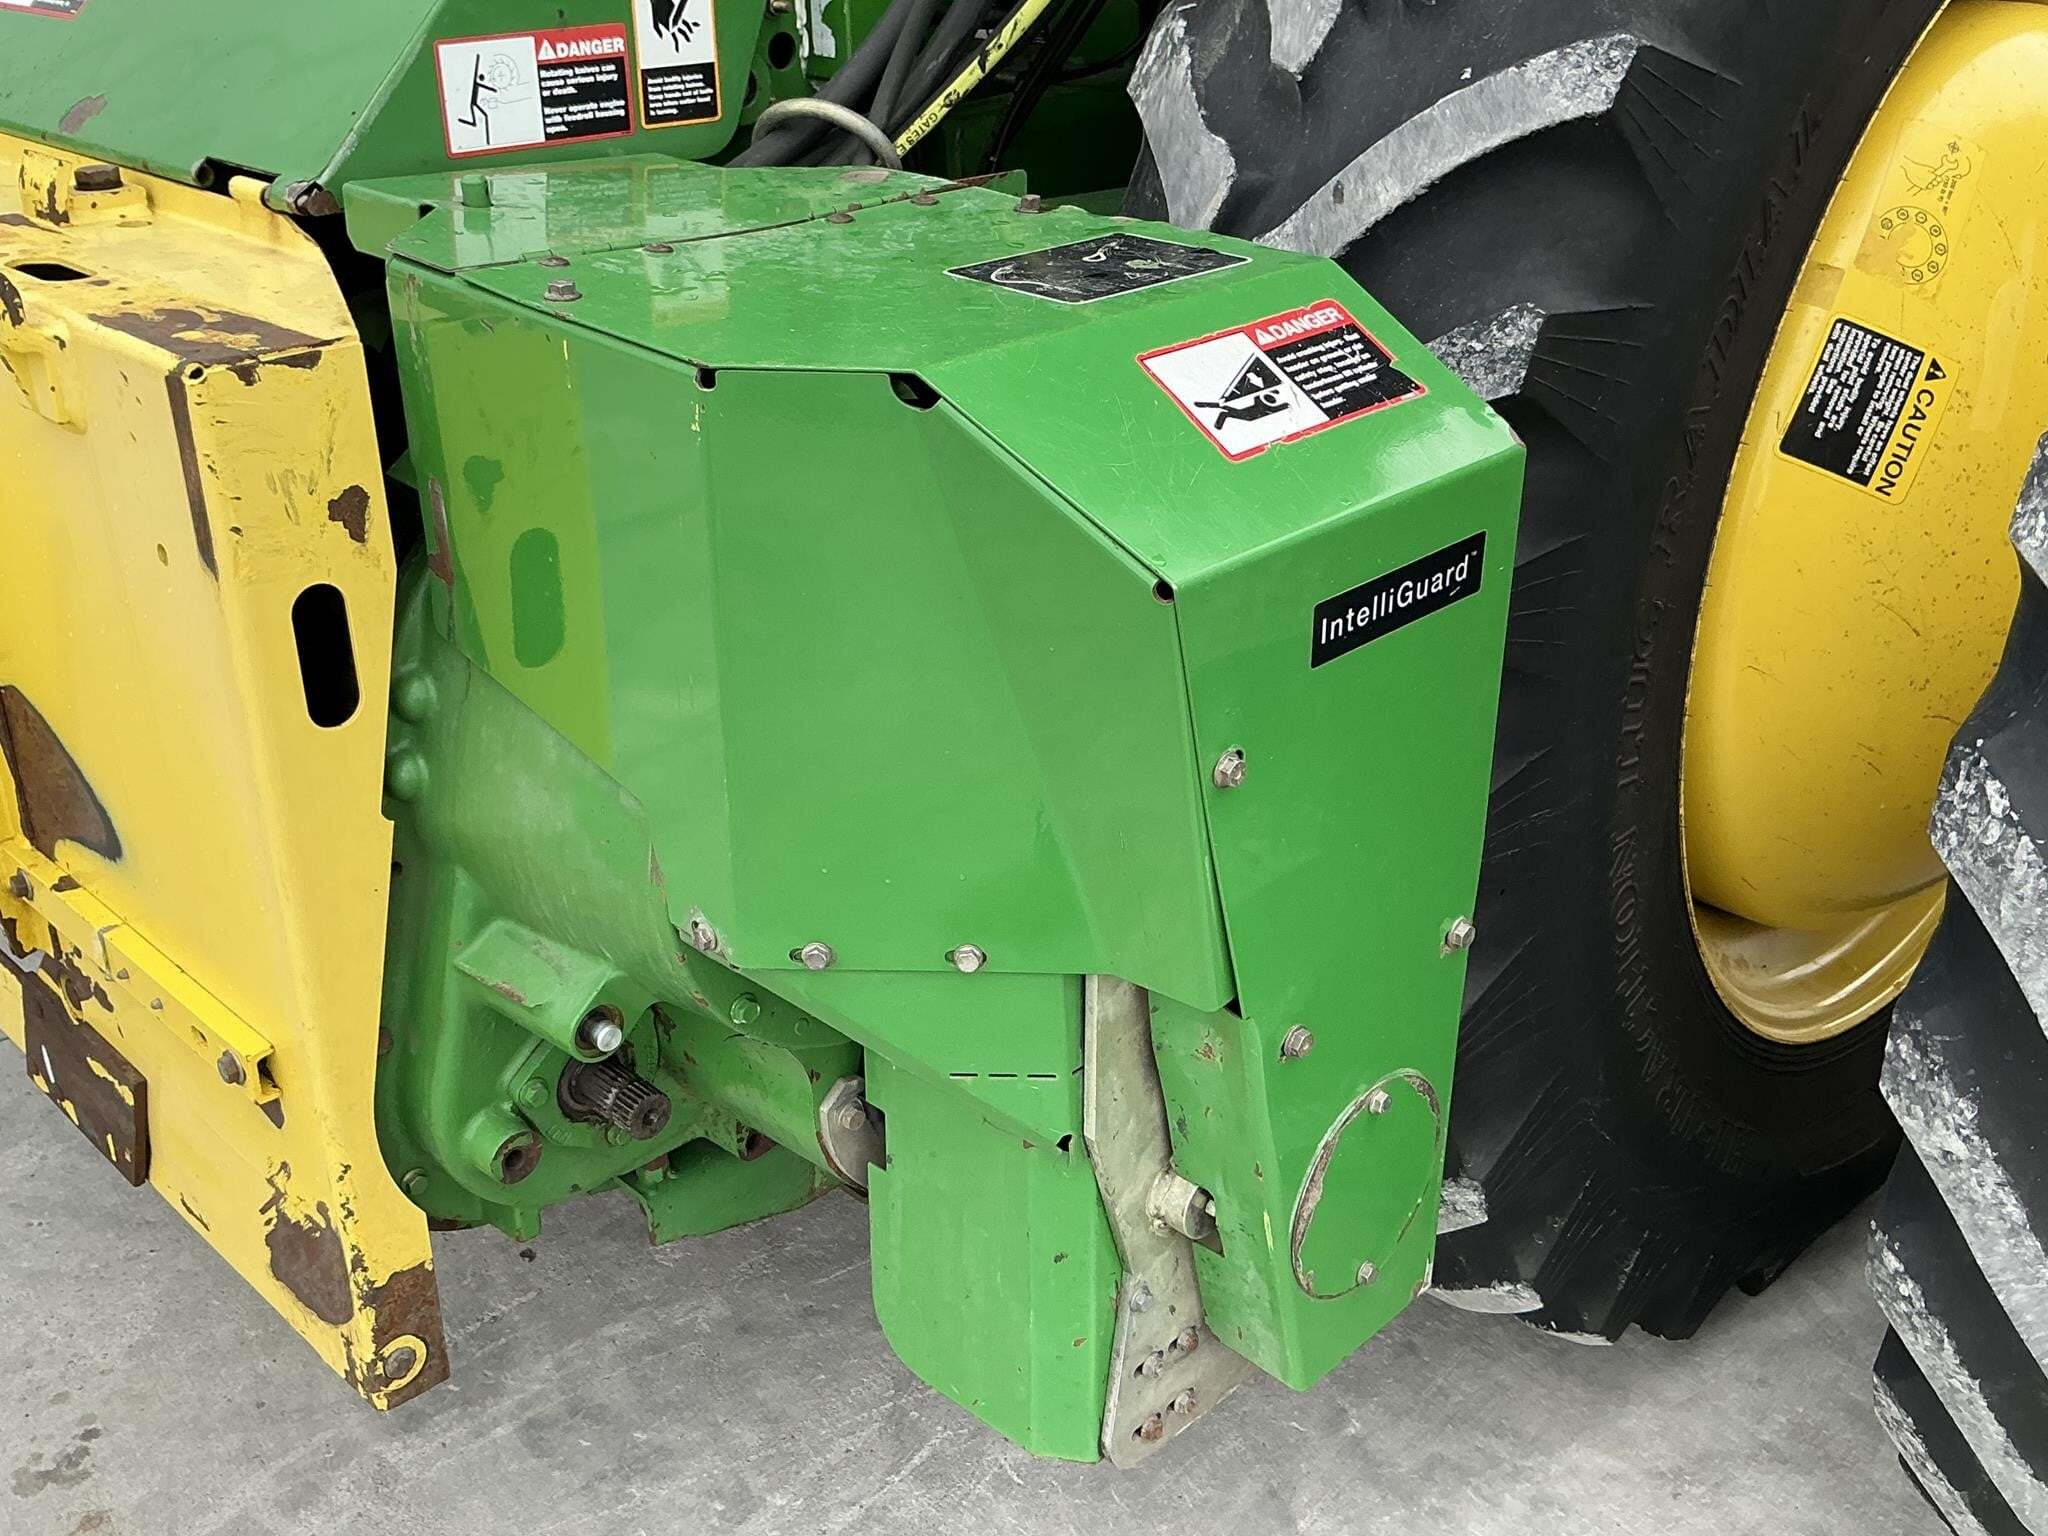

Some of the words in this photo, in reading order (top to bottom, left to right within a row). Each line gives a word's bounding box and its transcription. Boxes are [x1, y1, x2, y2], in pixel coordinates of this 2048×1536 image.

[556, 37, 625, 58] DANGER
[905, 112, 938, 145] GATES
[1267, 307, 1344, 340] DANGER
[1830, 322, 1843, 340] with
[1822, 342, 1834, 362] dual
[1825, 324, 1852, 374] instructions
[1833, 327, 1860, 375] installation.
[1844, 329, 1865, 368] provided
[1856, 333, 1873, 364] special
[1870, 337, 1882, 349] To
[1888, 345, 1900, 361] two
[1860, 351, 1874, 376] avoid
[1873, 341, 1892, 374] remove.
[1893, 348, 1906, 371] when
[1898, 351, 1913, 378] center
[1909, 355, 1922, 371] The
[1806, 364, 1826, 395] wheels.
[1825, 377, 1838, 395] See
[1839, 369, 1850, 383] for
[1846, 365, 1859, 386] pilot
[1876, 360, 1893, 390] people
[1894, 377, 1902, 389] of
[1901, 370, 1914, 391] dual
[1807, 375, 1829, 414] provided
[1823, 385, 1843, 420] removal
[1835, 387, 1850, 412] studs
[1846, 375, 1865, 404] bodily
[1872, 389, 1882, 400] to
[1874, 370, 1897, 411] removing.
[1881, 388, 1899, 417] weight.
[1860, 399, 1877, 426] install
[1889, 390, 1906, 419] wheels
[1814, 420, 1826, 439] and
[1827, 414, 1838, 429] are
[1833, 404, 1852, 432] injury,
[1856, 425, 1864, 436] or
[1860, 415, 1880, 445] Wheels
[1874, 420, 1885, 433] Be
[1879, 419, 1894, 440] have
[1861, 433, 1879, 463] careful
[1874, 440, 1884, 452] an
[1875, 389, 1935, 496] CAUTION
[1846, 445, 1865, 475] require
[1863, 452, 1878, 477] offset
